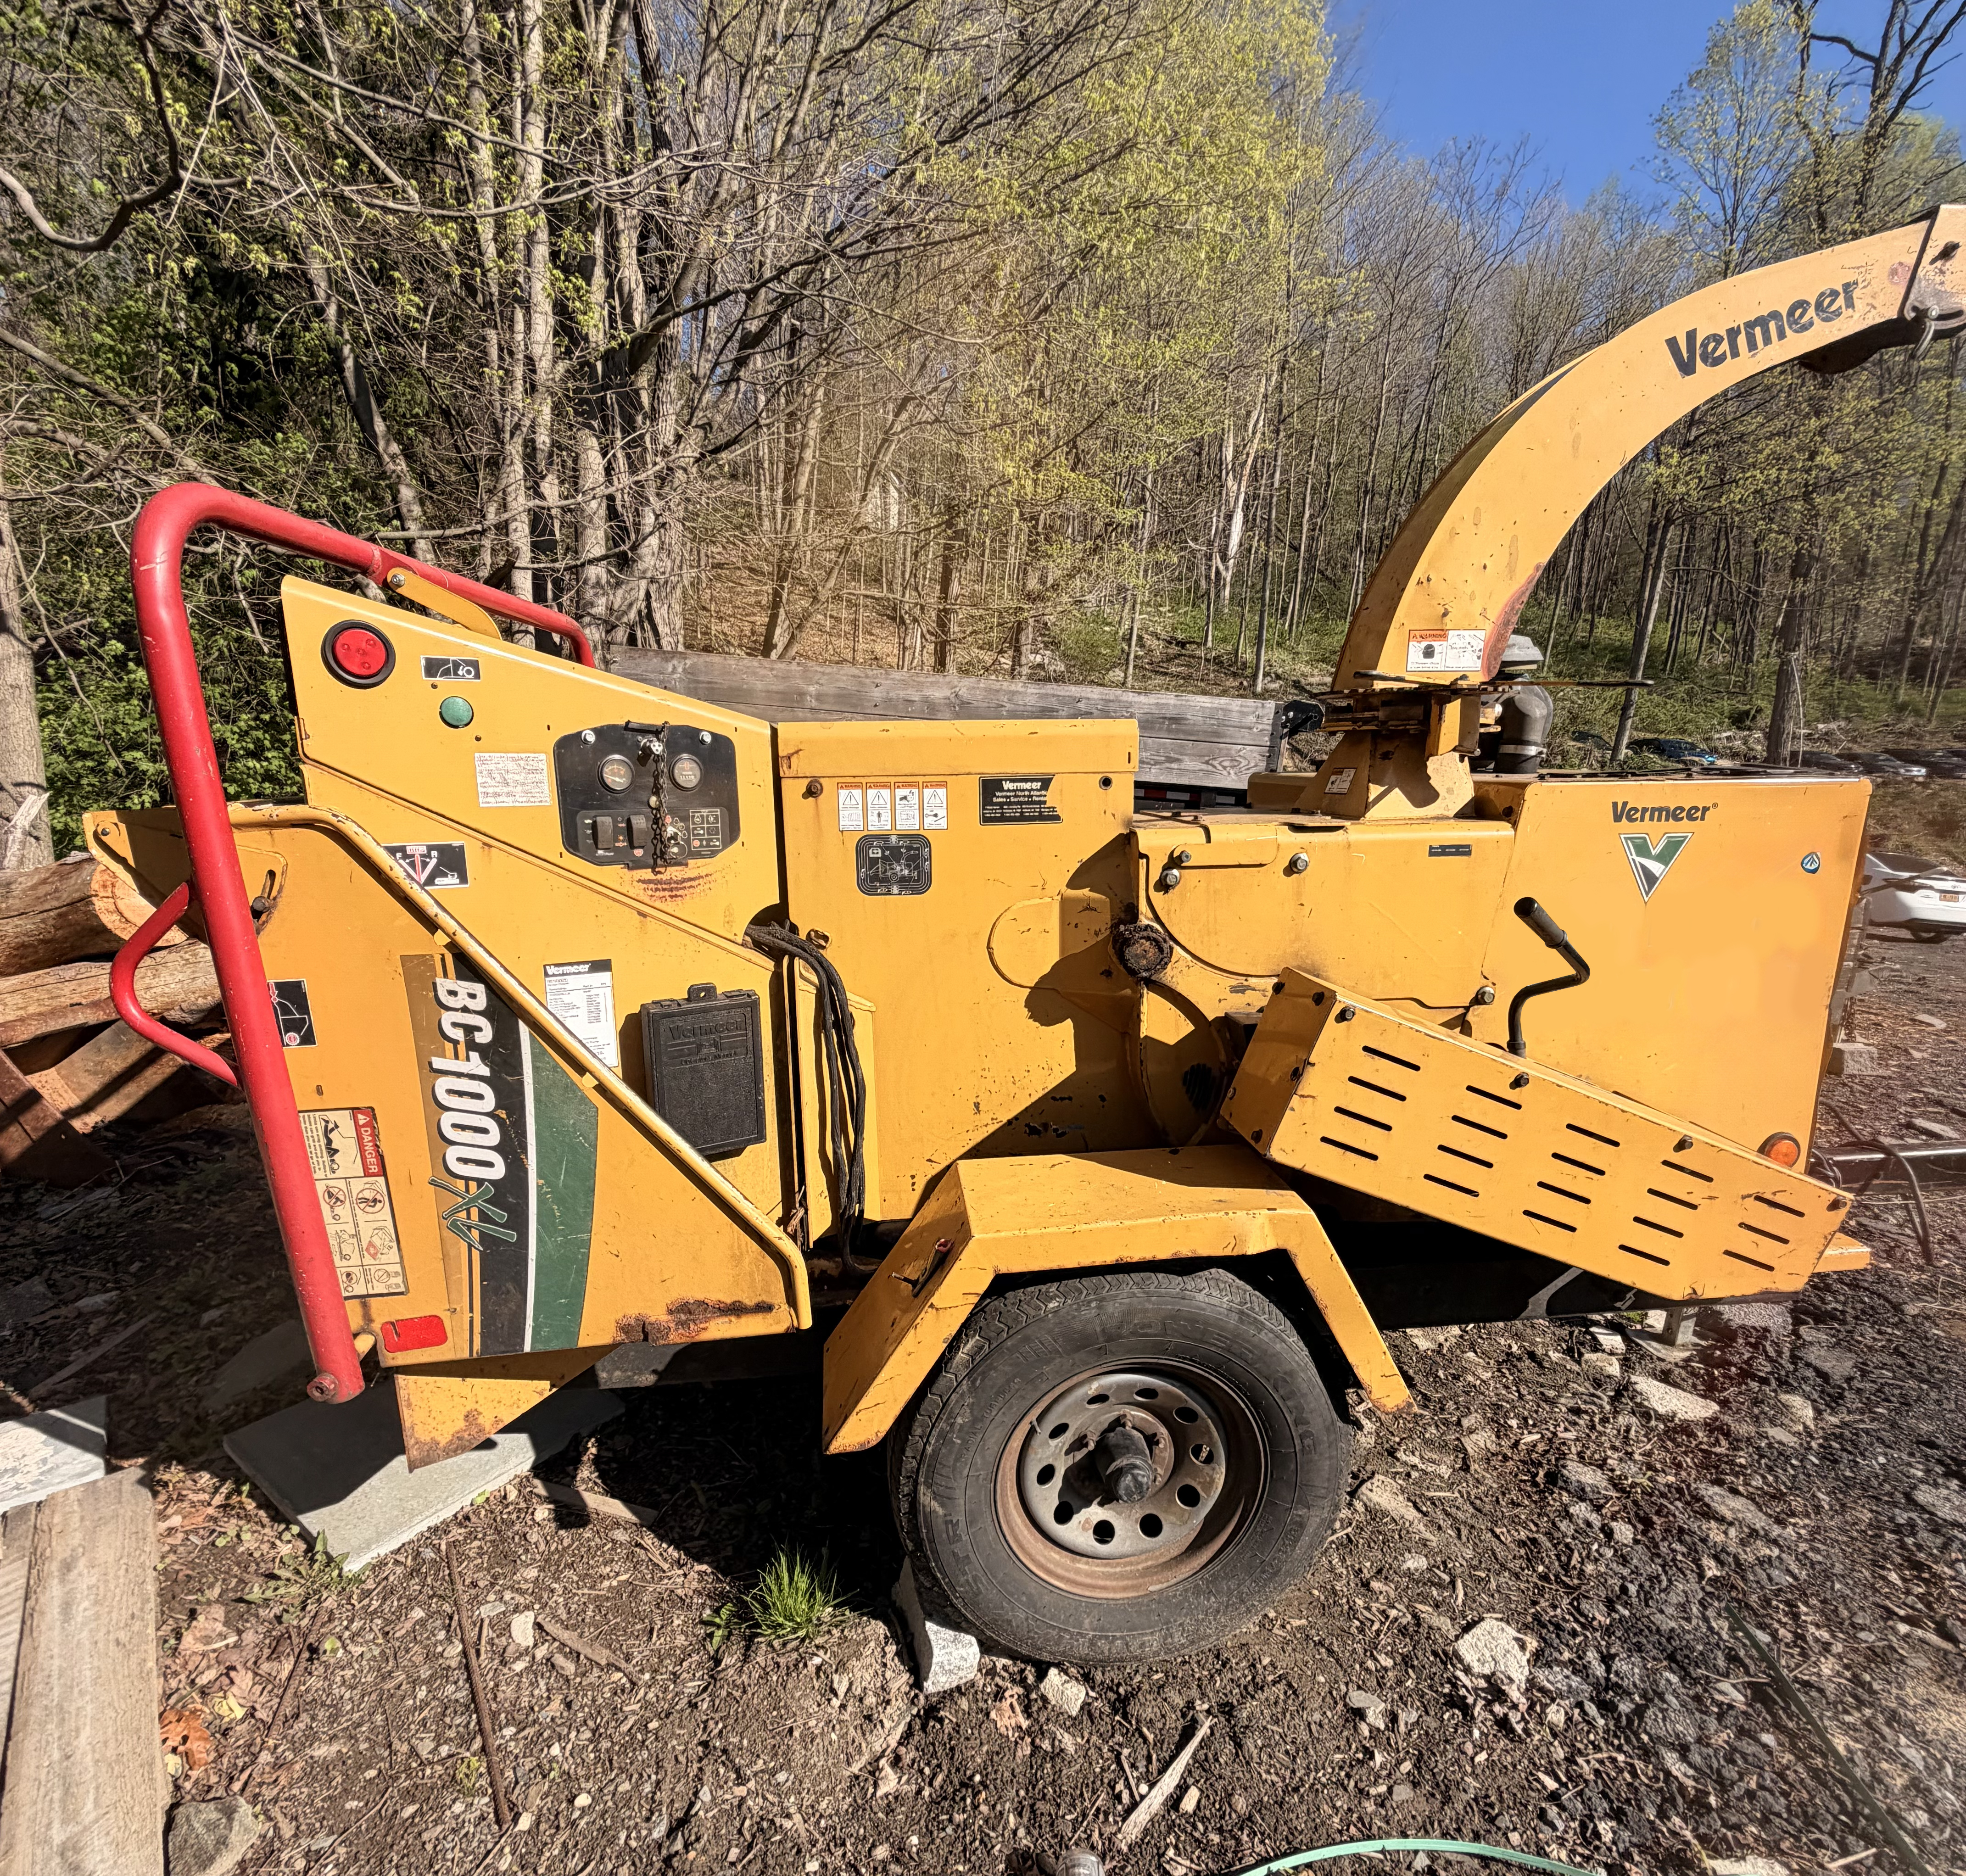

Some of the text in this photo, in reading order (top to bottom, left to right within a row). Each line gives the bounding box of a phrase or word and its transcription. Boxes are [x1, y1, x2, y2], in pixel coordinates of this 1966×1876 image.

[1664, 279, 1858, 379] Vermeer
[1002, 781, 1041, 790] Vermeer
[669, 1019, 743, 1040] Vermeer
[361, 1127, 378, 1173] DANGER
